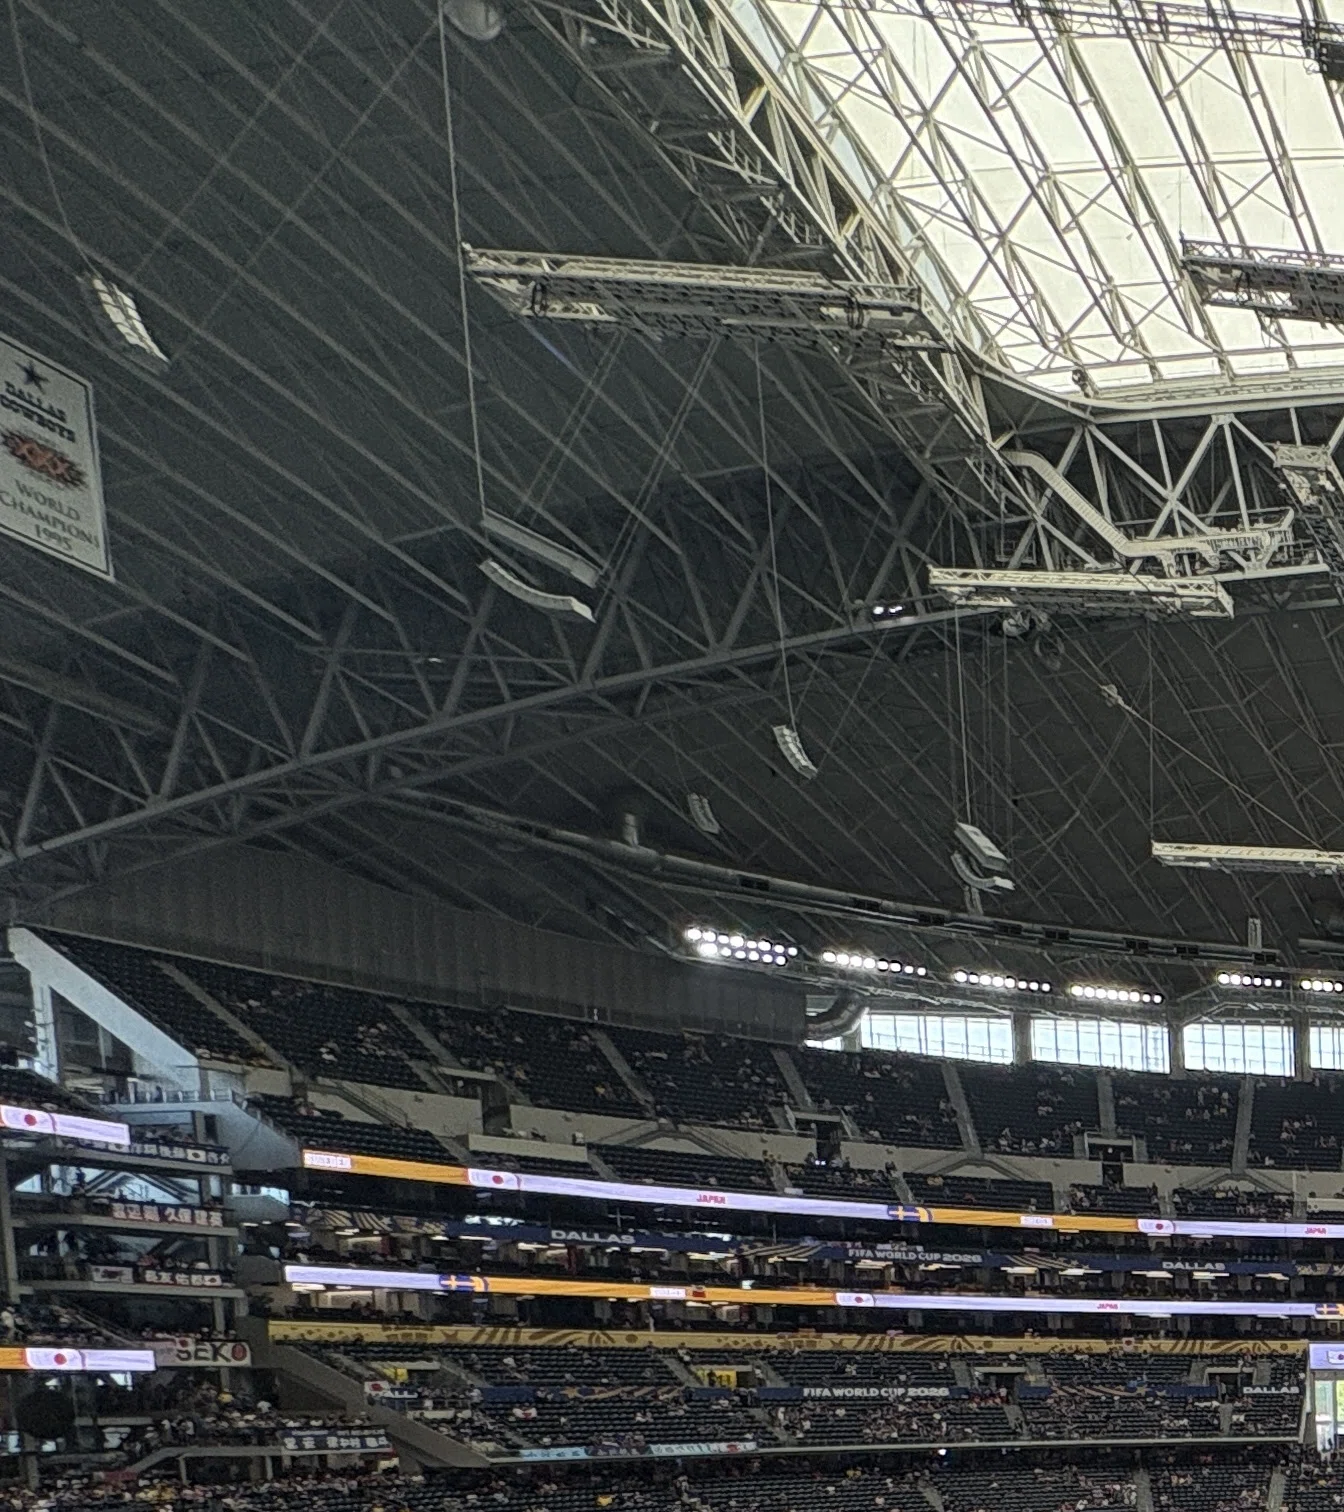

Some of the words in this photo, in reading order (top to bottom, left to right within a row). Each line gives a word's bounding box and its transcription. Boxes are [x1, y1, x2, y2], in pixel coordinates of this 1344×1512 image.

[14, 478, 81, 522] WORLD
[551, 1229, 636, 1245] DALLAS
[848, 1248, 872, 1259] FIFA
[875, 1250, 916, 1261] WORLD
[918, 1252, 941, 1262] CUP
[943, 1254, 983, 1264] 2026
[1161, 1260, 1226, 1271] DALLAS
[803, 1386, 829, 1397] FIFA
[831, 1386, 876, 1397] WORLD
[878, 1386, 904, 1397] CUP
[907, 1386, 950, 1397] 2026
[1243, 1386, 1299, 1395] DALLAS
